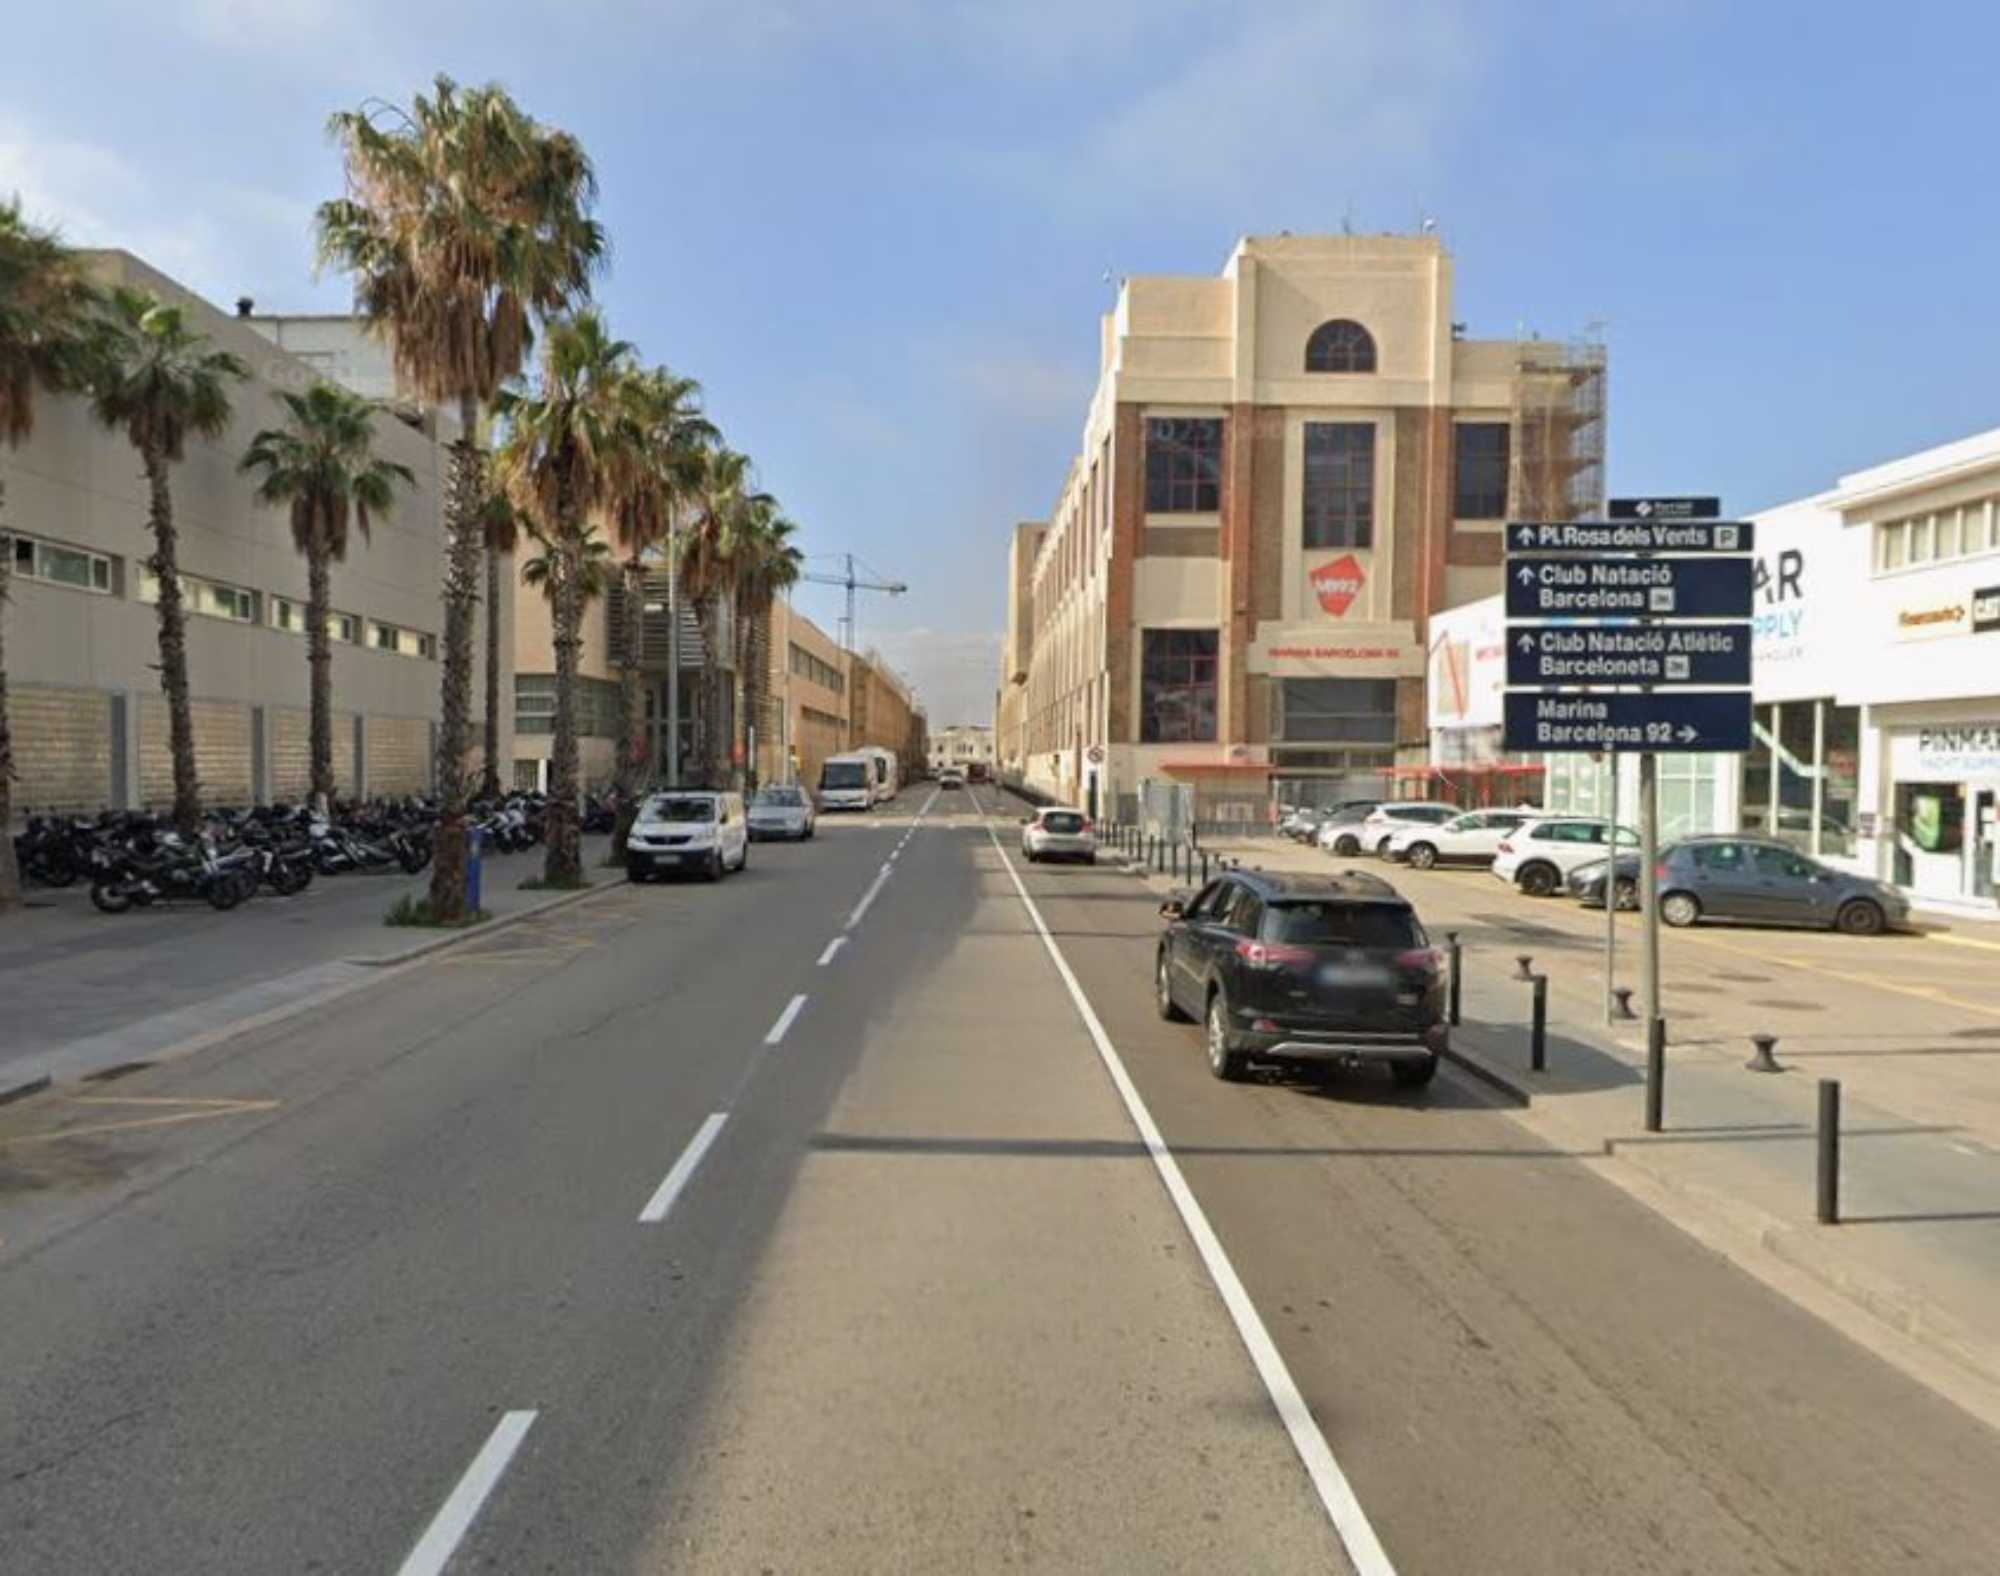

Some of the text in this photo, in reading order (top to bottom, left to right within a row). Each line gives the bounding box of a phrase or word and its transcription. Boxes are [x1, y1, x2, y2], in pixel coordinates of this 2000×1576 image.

[1563, 527, 1610, 546] Rosa
[1652, 526, 1708, 545] Vents
[1539, 564, 1672, 584] Club Natació
[1540, 589, 1644, 607] Barcelona
[1540, 634, 1585, 651] Club
[1589, 633, 1664, 651] Natació
[1540, 657, 1659, 675] Barceloneta
[1538, 701, 1608, 718] Marina
[1538, 723, 1672, 742] Barcelona 92
